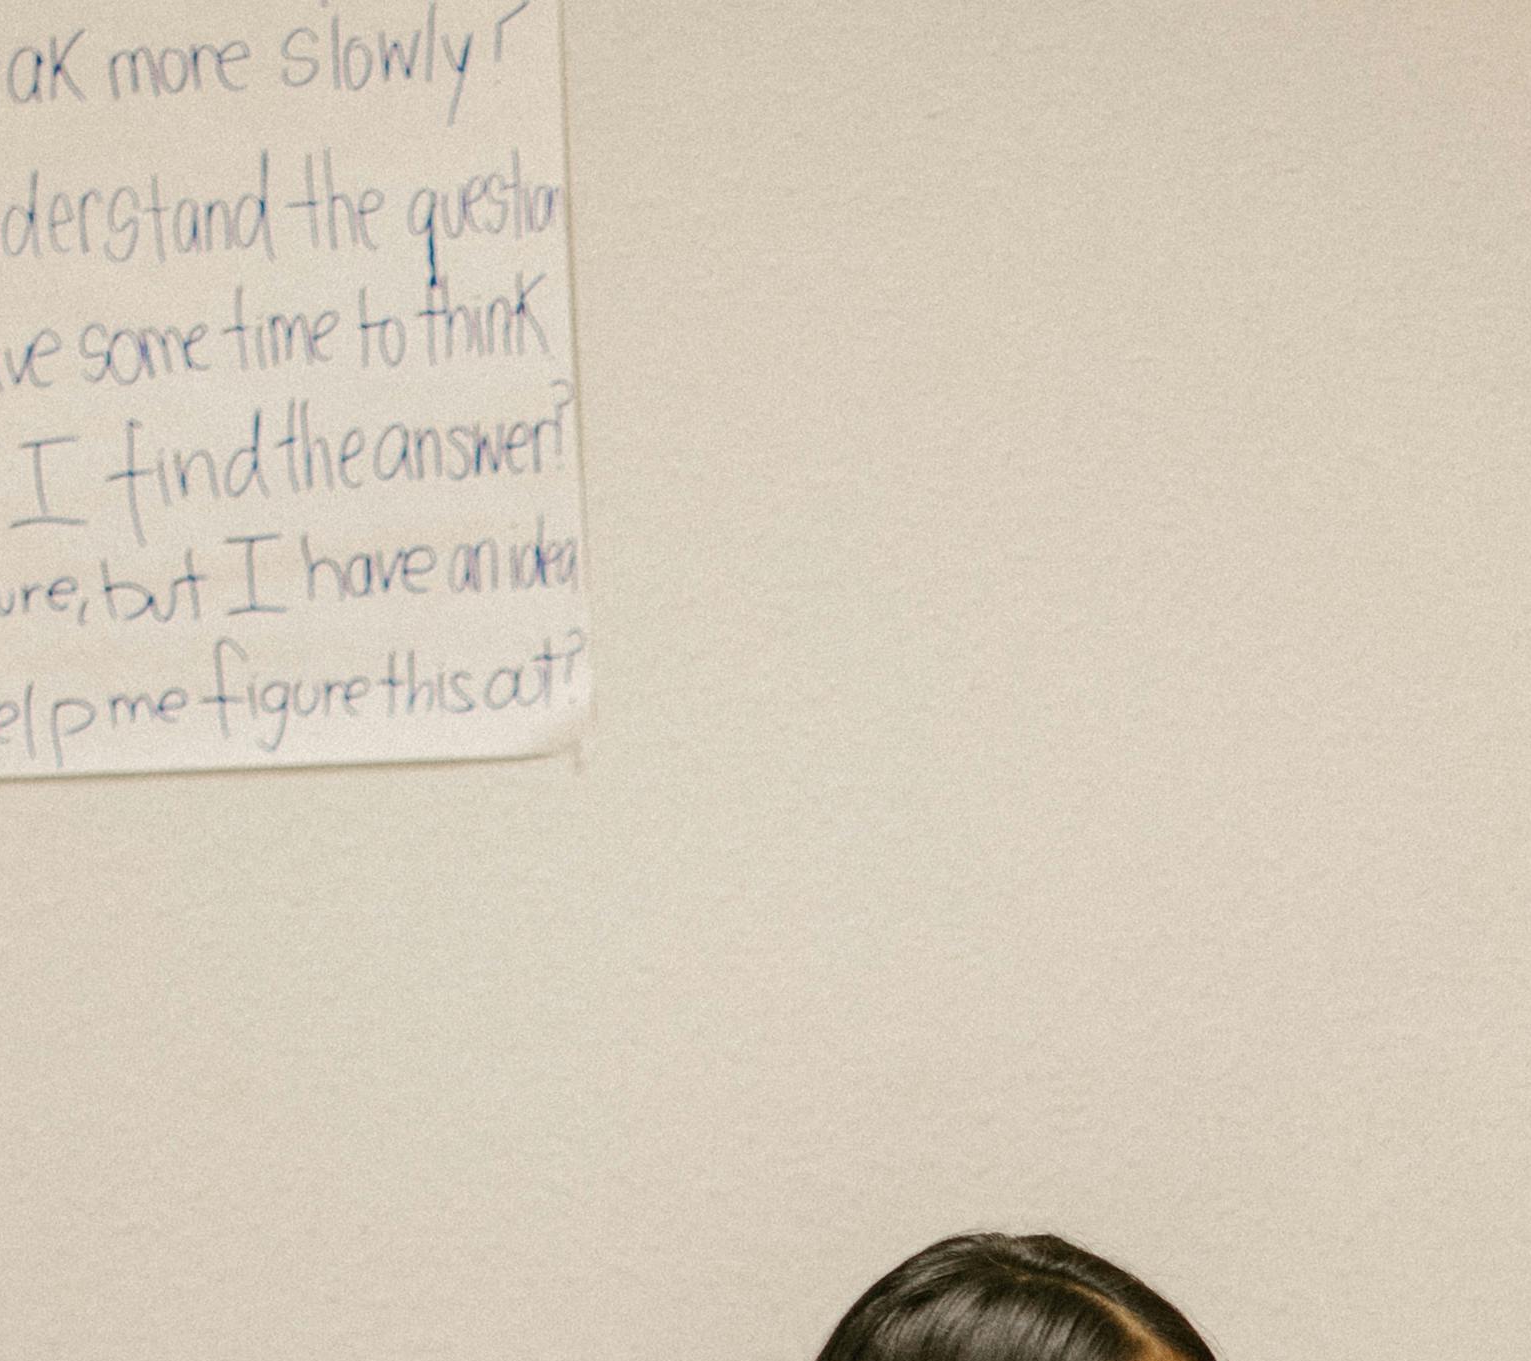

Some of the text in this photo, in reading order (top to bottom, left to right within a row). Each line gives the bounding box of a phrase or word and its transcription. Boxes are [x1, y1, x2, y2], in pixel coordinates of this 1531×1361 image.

[109, 40, 249, 98] more
[287, 147, 384, 249] the
[78, 322, 211, 385] some
[224, 286, 340, 370] time
[360, 287, 405, 368] to
[418, 272, 556, 365] think
[10, 435, 87, 529] I
[106, 410, 269, 547] find
[278, 399, 366, 493] the
[100, 547, 207, 622] but
[225, 534, 287, 615] I
[301, 534, 437, 600] have
[448, 537, 499, 593] an
[510, 514, 578, 593] idea
[109, 687, 188, 730] me
[201, 637, 369, 752] figure
[370, 649, 475, 717] this
